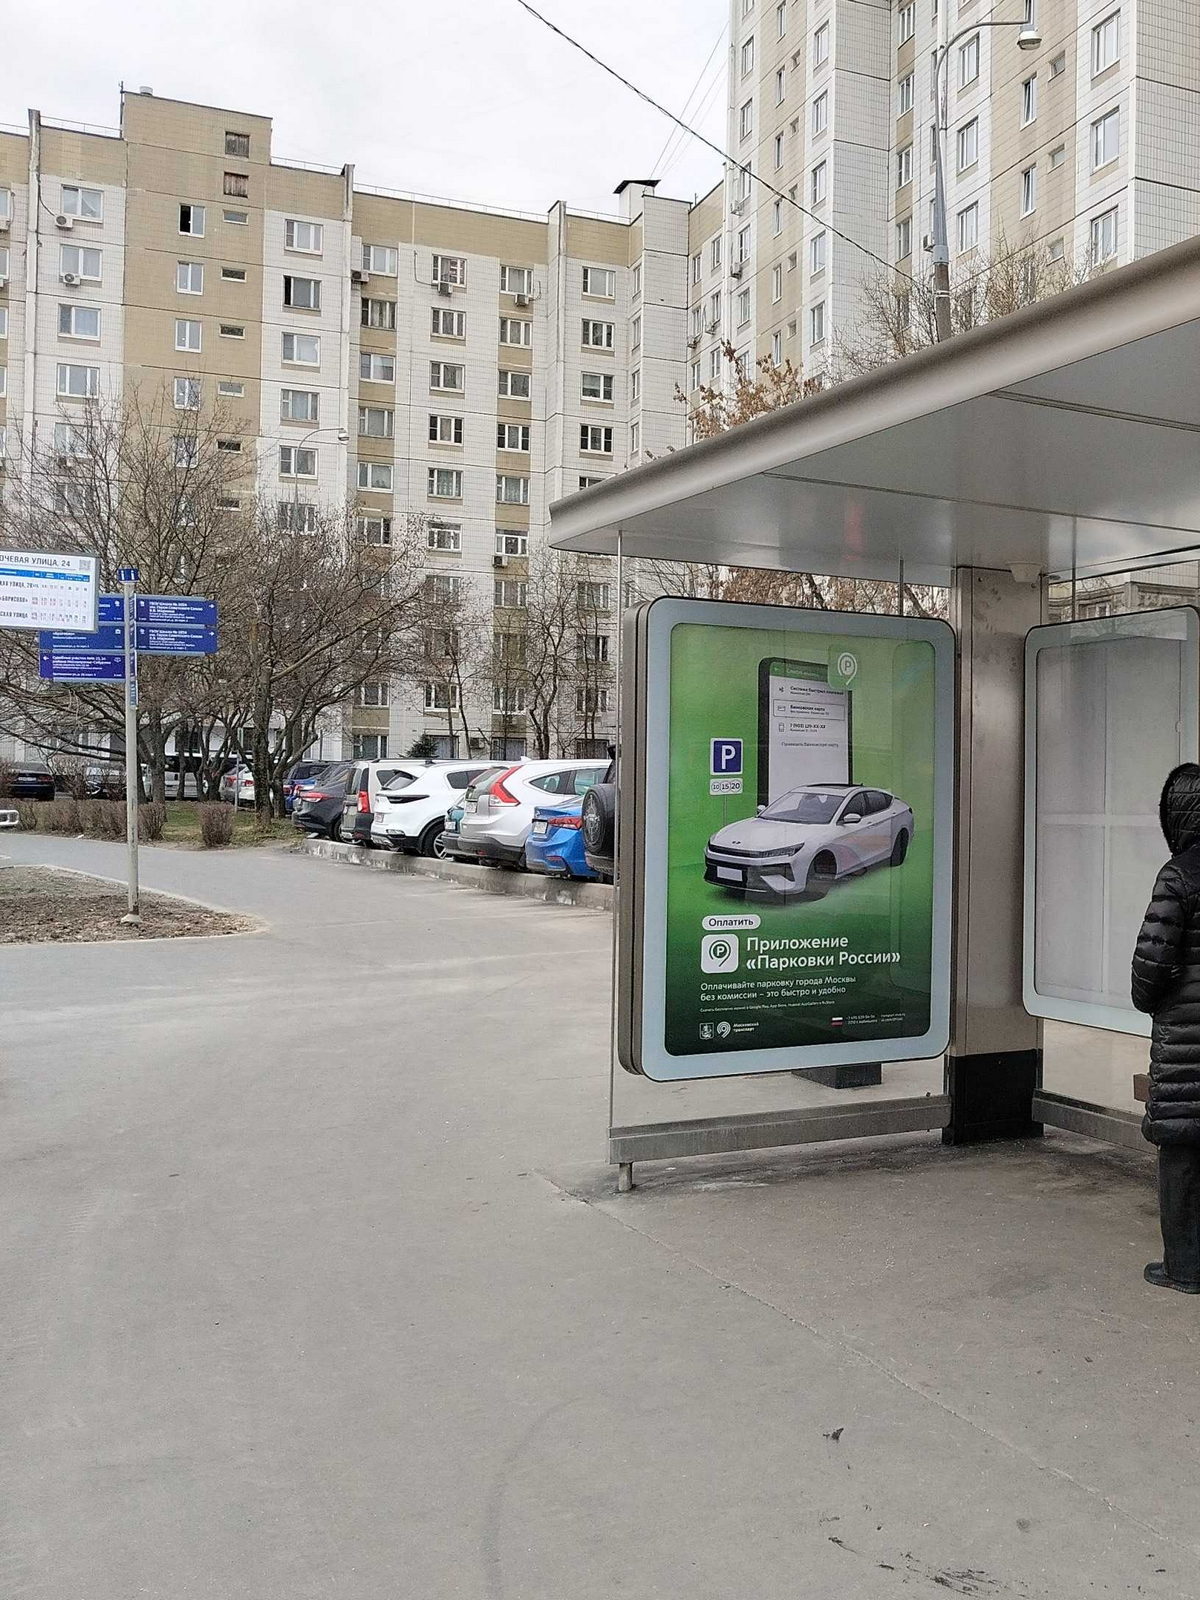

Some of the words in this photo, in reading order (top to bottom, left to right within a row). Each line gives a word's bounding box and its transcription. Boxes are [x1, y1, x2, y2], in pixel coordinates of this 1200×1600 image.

[721, 745, 736, 769] P
[708, 918, 754, 927] Оплатить
[747, 936, 849, 954] Приложение
[746, 955, 834, 972] «Парковки
[839, 951, 901, 965] России»
[700, 981, 755, 991] Оплачивайте
[756, 979, 795, 989] парковку
[795, 977, 823, 987] города
[824, 976, 857, 984] Москвы
[700, 993, 716, 1001] без
[717, 992, 757, 1000] комиссии
[766, 990, 779, 998] это
[781, 988, 809, 998] быстро
[818, 985, 846, 996] удобно
